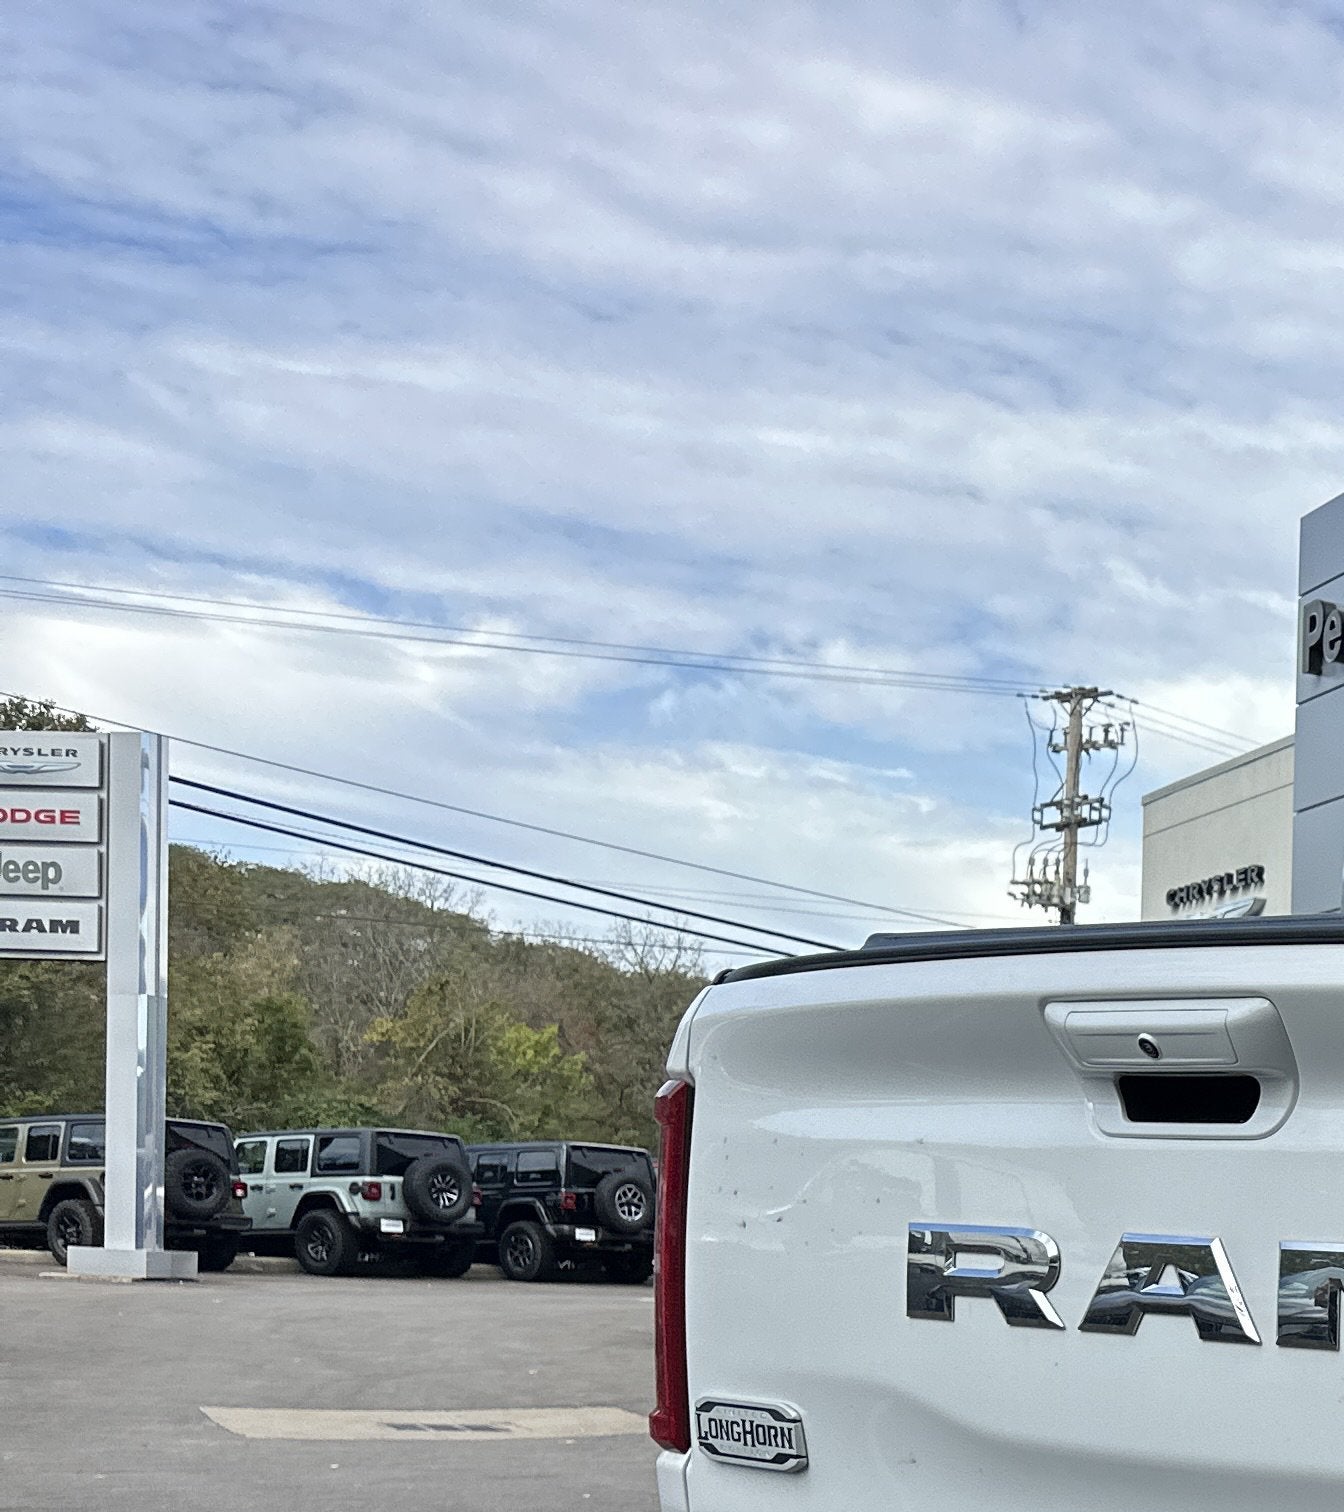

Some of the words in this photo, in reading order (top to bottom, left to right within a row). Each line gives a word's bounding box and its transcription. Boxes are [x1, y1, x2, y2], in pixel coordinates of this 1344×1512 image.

[0, 850, 63, 890] eep
[1166, 865, 1265, 907] CHRYSLER
[0, 917, 80, 934] RAM
